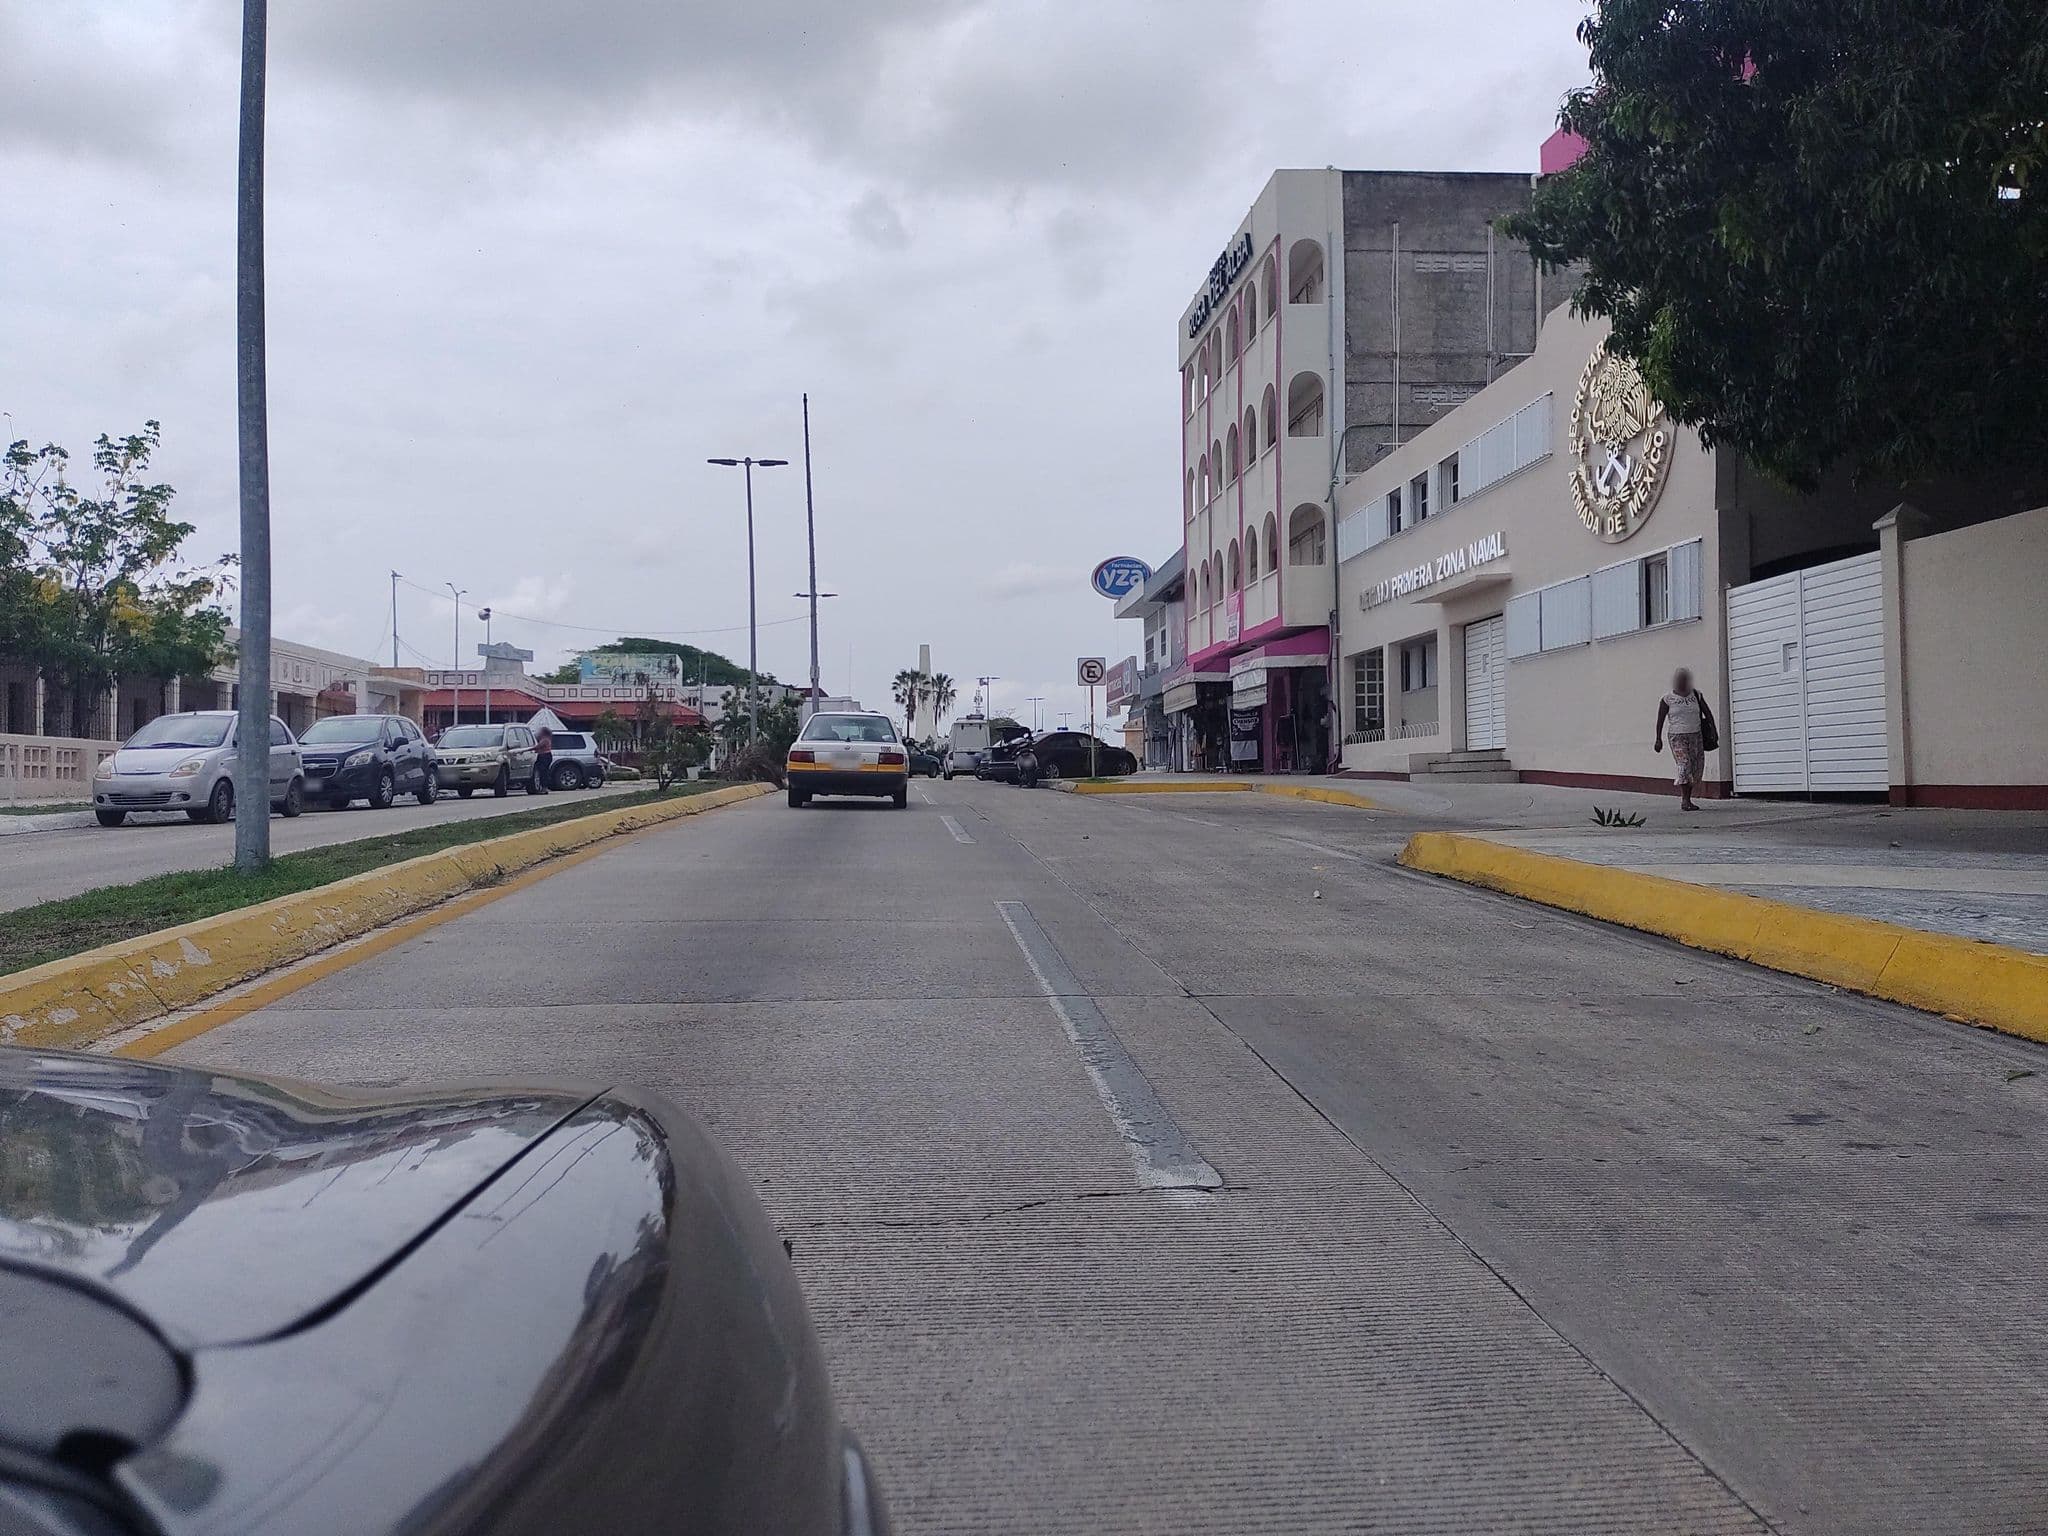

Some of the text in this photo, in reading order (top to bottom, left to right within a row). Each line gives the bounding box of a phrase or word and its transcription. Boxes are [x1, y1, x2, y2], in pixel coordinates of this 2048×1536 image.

[1567, 471, 1600, 536] ARMADA
[1607, 513, 1624, 536] DE
[1102, 568, 1144, 590] yza
[1391, 562, 1433, 599] PRIMERA
[1436, 547, 1466, 581] ZONA
[1469, 531, 1506, 567] NAVAL
